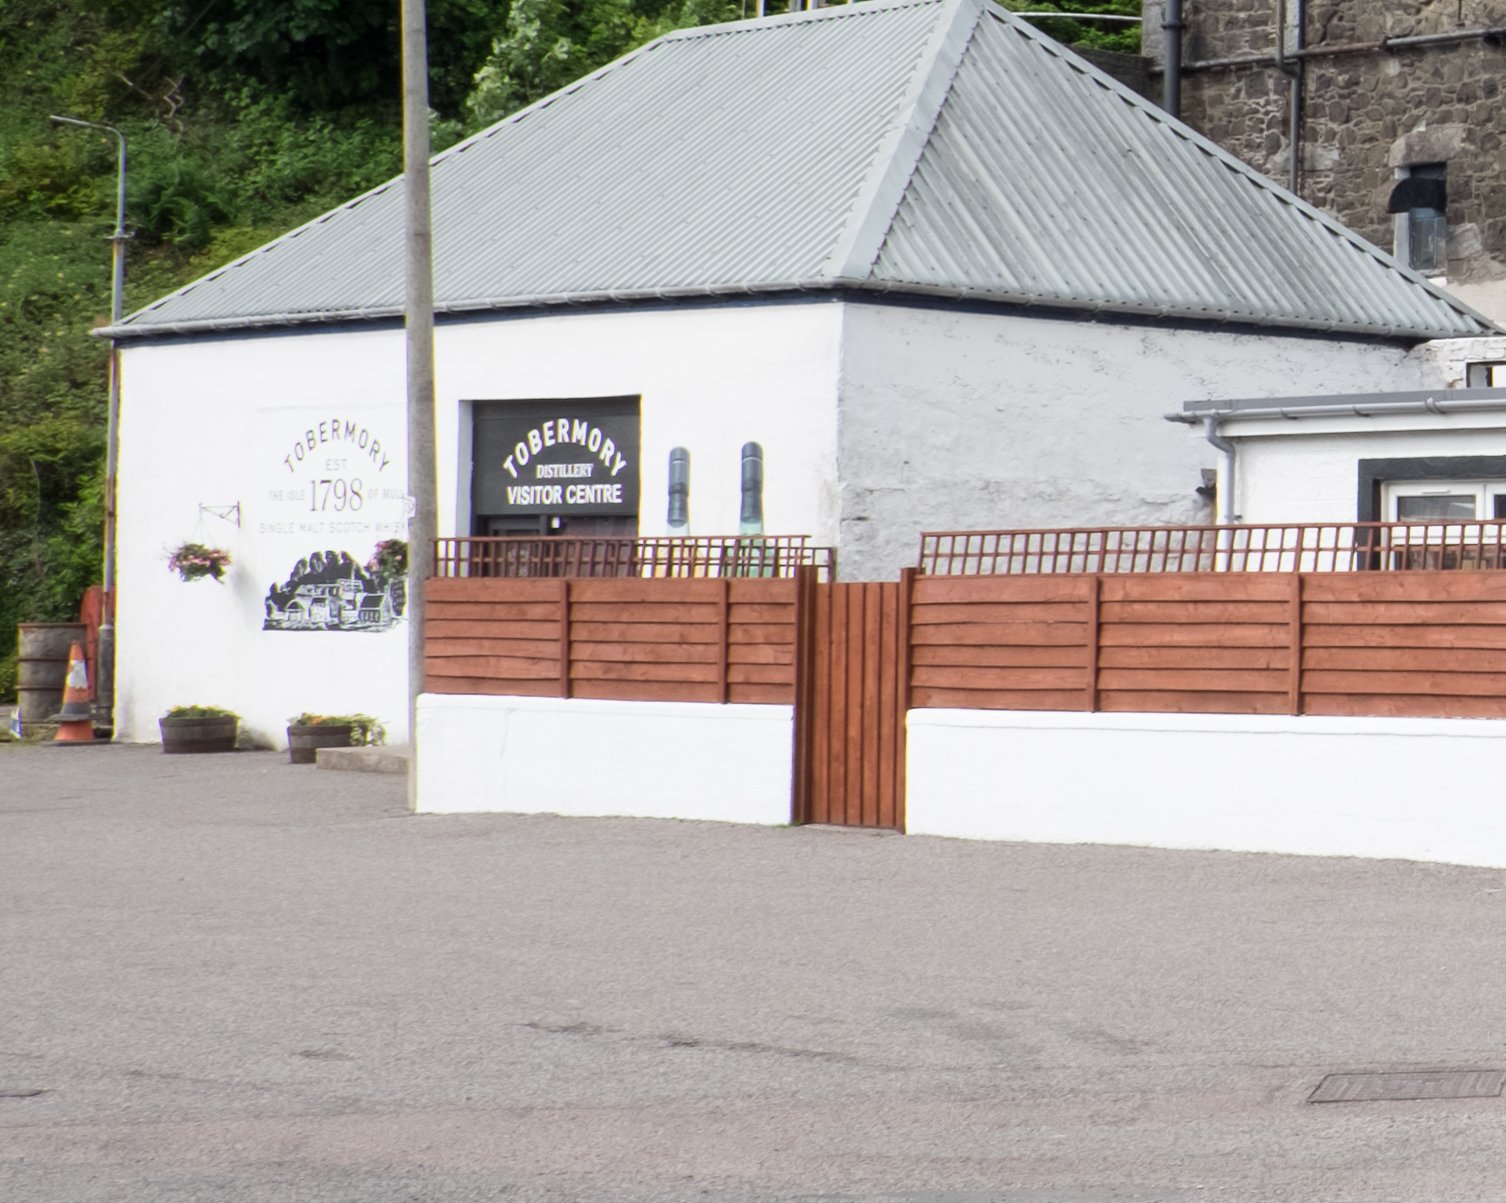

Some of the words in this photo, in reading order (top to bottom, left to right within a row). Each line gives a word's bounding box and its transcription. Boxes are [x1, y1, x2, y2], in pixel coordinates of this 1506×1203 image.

[284, 419, 390, 473] TOBERMORY
[502, 417, 627, 478] TOBERMORY
[536, 463, 594, 479] DISTILLERY
[287, 490, 306, 501] ISLE
[310, 478, 363, 512] 1798
[507, 485, 563, 505] VISITOR
[565, 484, 623, 504] CENTRE
[259, 522, 295, 534] SINGLE
[300, 522, 324, 533] MALT
[329, 522, 370, 533] SCOTCH
